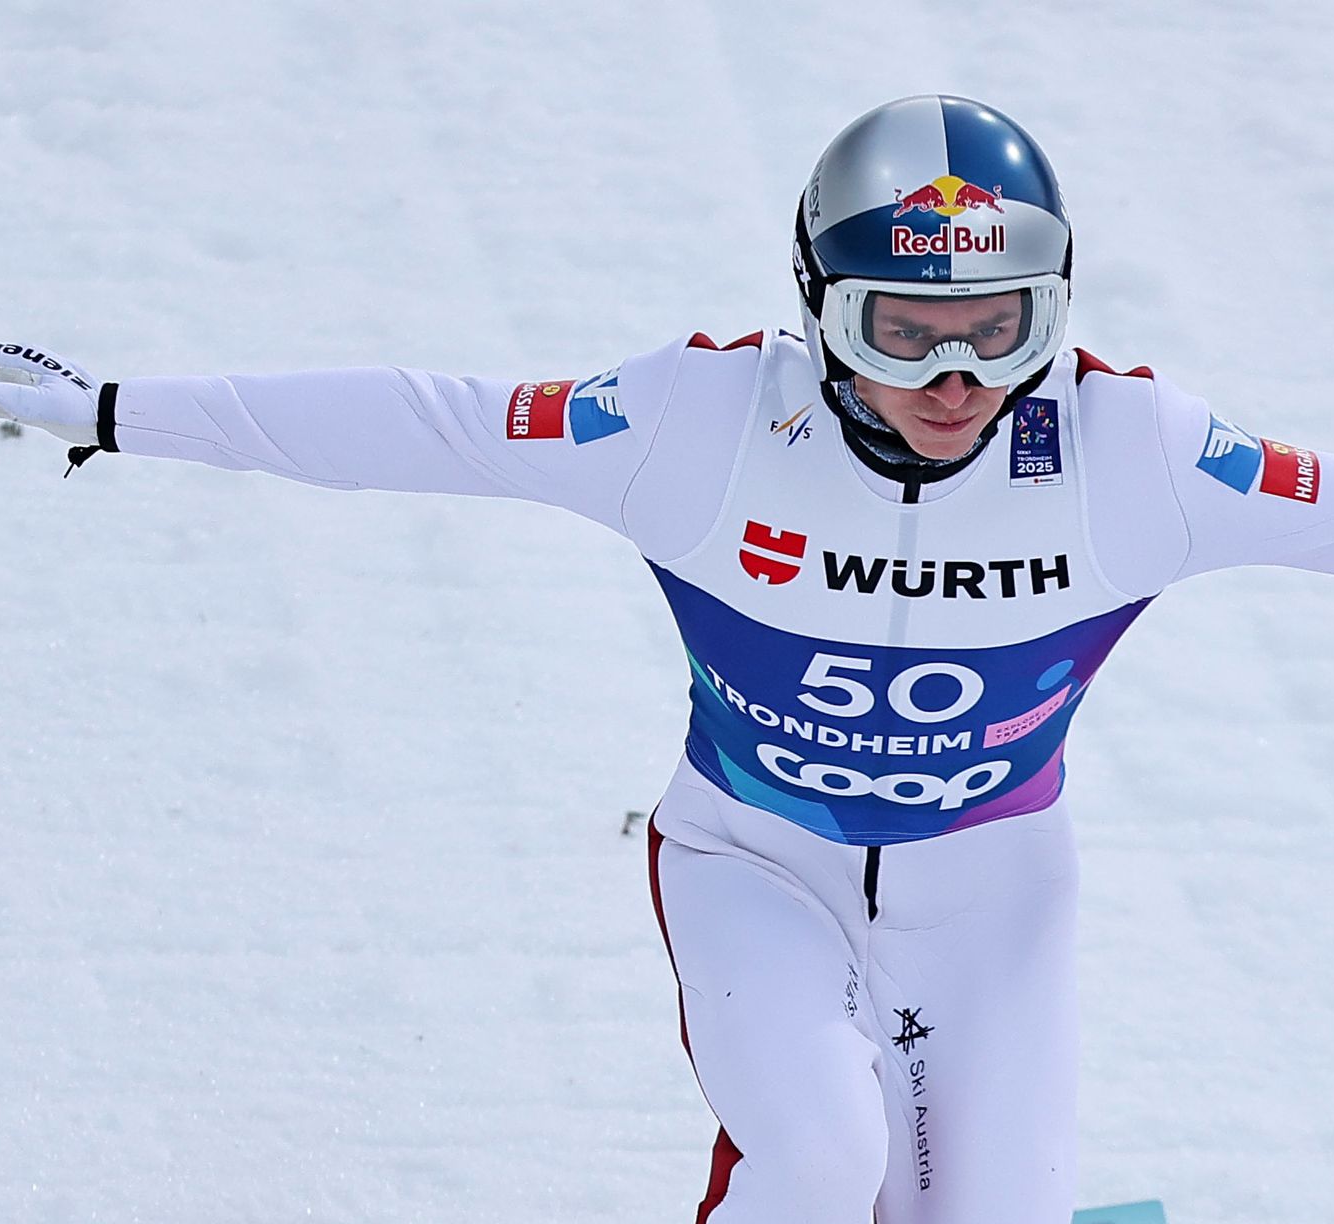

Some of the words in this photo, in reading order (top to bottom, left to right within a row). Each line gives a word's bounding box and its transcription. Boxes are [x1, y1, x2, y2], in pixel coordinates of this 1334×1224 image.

[892, 225, 949, 255] Red
[954, 224, 1006, 254] Bull
[513, 383, 538, 436] ASSNER
[1017, 462, 1054, 473] 2025
[822, 551, 1070, 599] WÜRTH
[706, 664, 972, 756] TRONDHEIM
[796, 652, 985, 723] 50
[757, 743, 1012, 811] coop
[910, 1060, 926, 1097] Ski
[915, 1105, 933, 1191] Austria
